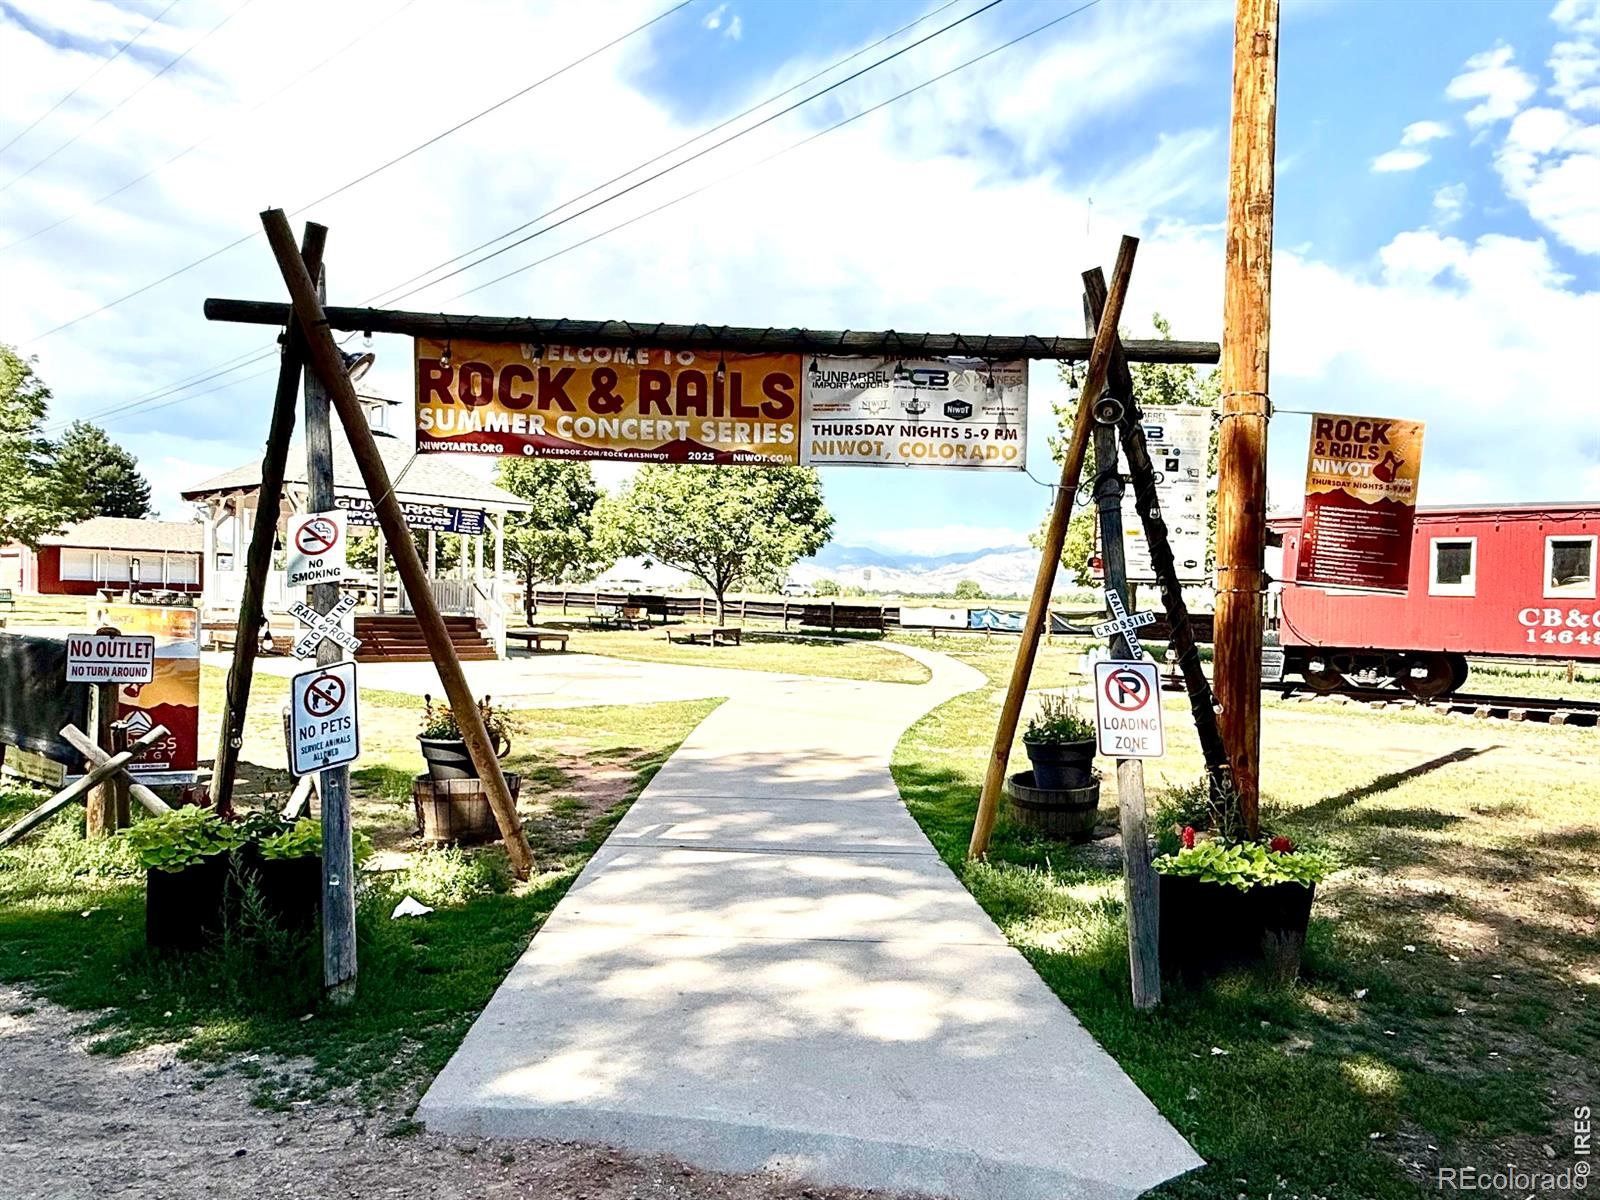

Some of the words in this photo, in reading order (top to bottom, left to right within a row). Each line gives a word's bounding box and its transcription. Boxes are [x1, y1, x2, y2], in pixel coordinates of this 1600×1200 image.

[520, 343, 649, 365] WELCOME
[419, 359, 577, 412] ROCK
[588, 367, 625, 416] &
[639, 369, 794, 420] RAILS
[812, 381, 848, 389] IMPORT
[850, 381, 889, 389] MOTORS
[420, 408, 546, 436] SUMMER
[556, 416, 690, 442] CONCERT
[701, 419, 795, 444] SERIES
[812, 424, 895, 437] THURSDAY
[900, 425, 960, 438] NIGHTS
[963, 426, 989, 439] 5-9
[994, 427, 1018, 440] PM
[1315, 418, 1392, 445] ROCK
[419, 441, 504, 453] NIWOTARTS.ORG
[687, 452, 715, 461] 2025
[732, 453, 793, 463] NIWOT.COM
[811, 440, 892, 459] NIWOT,
[898, 441, 1018, 460] COLORADO
[1314, 441, 1326, 457] &
[1329, 442, 1380, 460] RAILS
[1311, 458, 1374, 478] NIWOT
[1311, 478, 1351, 488] THURSDAY
[1353, 481, 1384, 491] NIGHTS
[334, 498, 453, 517] GUNRREL
[308, 558, 324, 569] NO
[291, 567, 341, 583] SMOKING
[293, 604, 319, 625] RAIL
[329, 625, 359, 650] ROAD
[296, 596, 355, 656] CROSSING
[1096, 612, 1154, 636] CROSSING
[1108, 592, 1125, 619] RAIL
[1125, 629, 1142, 660] ROAD
[70, 640, 93, 657] NO
[96, 641, 151, 659] OUTLET
[71, 665, 85, 676] NO
[86, 666, 109, 677] TURN
[111, 666, 148, 678] AROUND
[299, 725, 316, 741] NO
[321, 716, 351, 735] PETS
[1103, 717, 1157, 730] LOADING
[301, 741, 323, 755] SERVICE
[325, 734, 351, 748] ANIMALS
[1115, 736, 1149, 749] ZONE
[313, 748, 339, 761] ALLOWED
